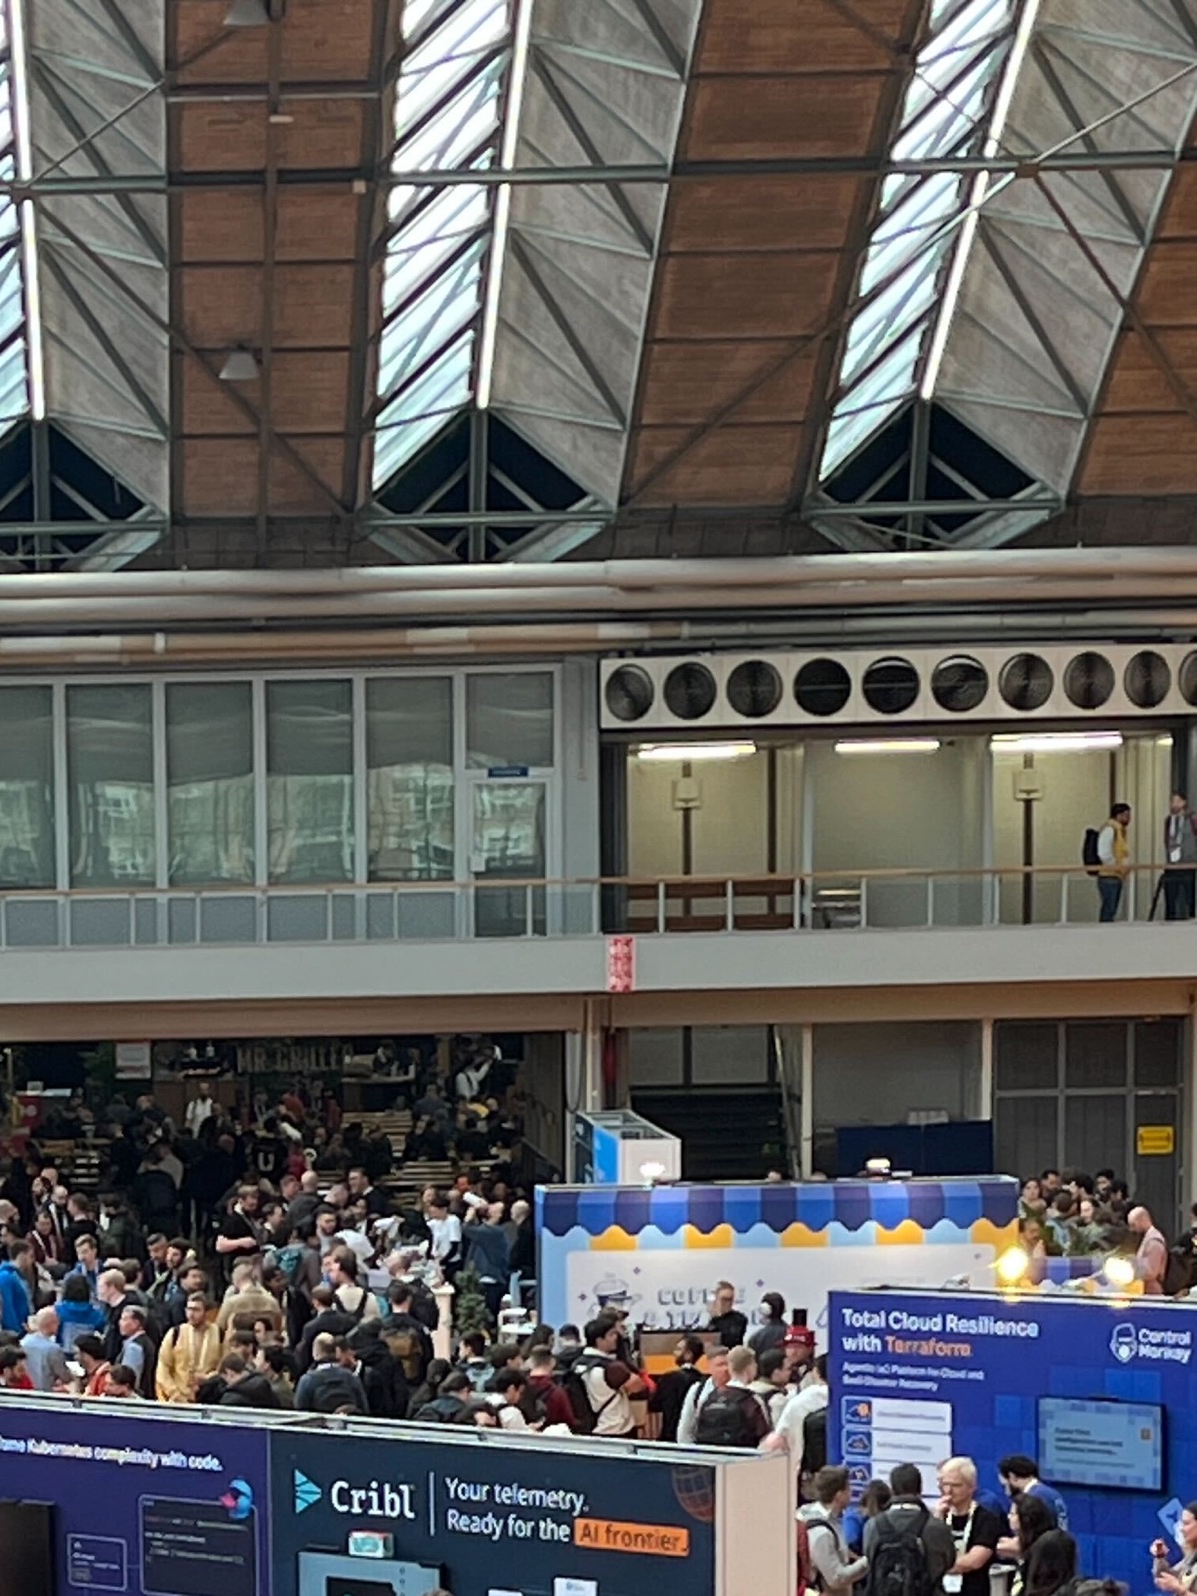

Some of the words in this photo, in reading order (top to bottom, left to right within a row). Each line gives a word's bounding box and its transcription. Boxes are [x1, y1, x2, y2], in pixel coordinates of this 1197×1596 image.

[841, 1308, 886, 1329] Total
[888, 1311, 943, 1332] Cloud
[946, 1313, 1039, 1338] Resilience
[1138, 1328, 1191, 1345] Control
[842, 1332, 882, 1353] with
[160, 1450, 187, 1467] with
[331, 1480, 415, 1519] Cribl
[445, 1477, 490, 1503] Your
[494, 1482, 589, 1516] telemetry.
[446, 1508, 503, 1541] Ready
[508, 1514, 536, 1539] for
[539, 1518, 571, 1542] the
[579, 1521, 600, 1542] AI
[604, 1524, 689, 1552] frontier.
